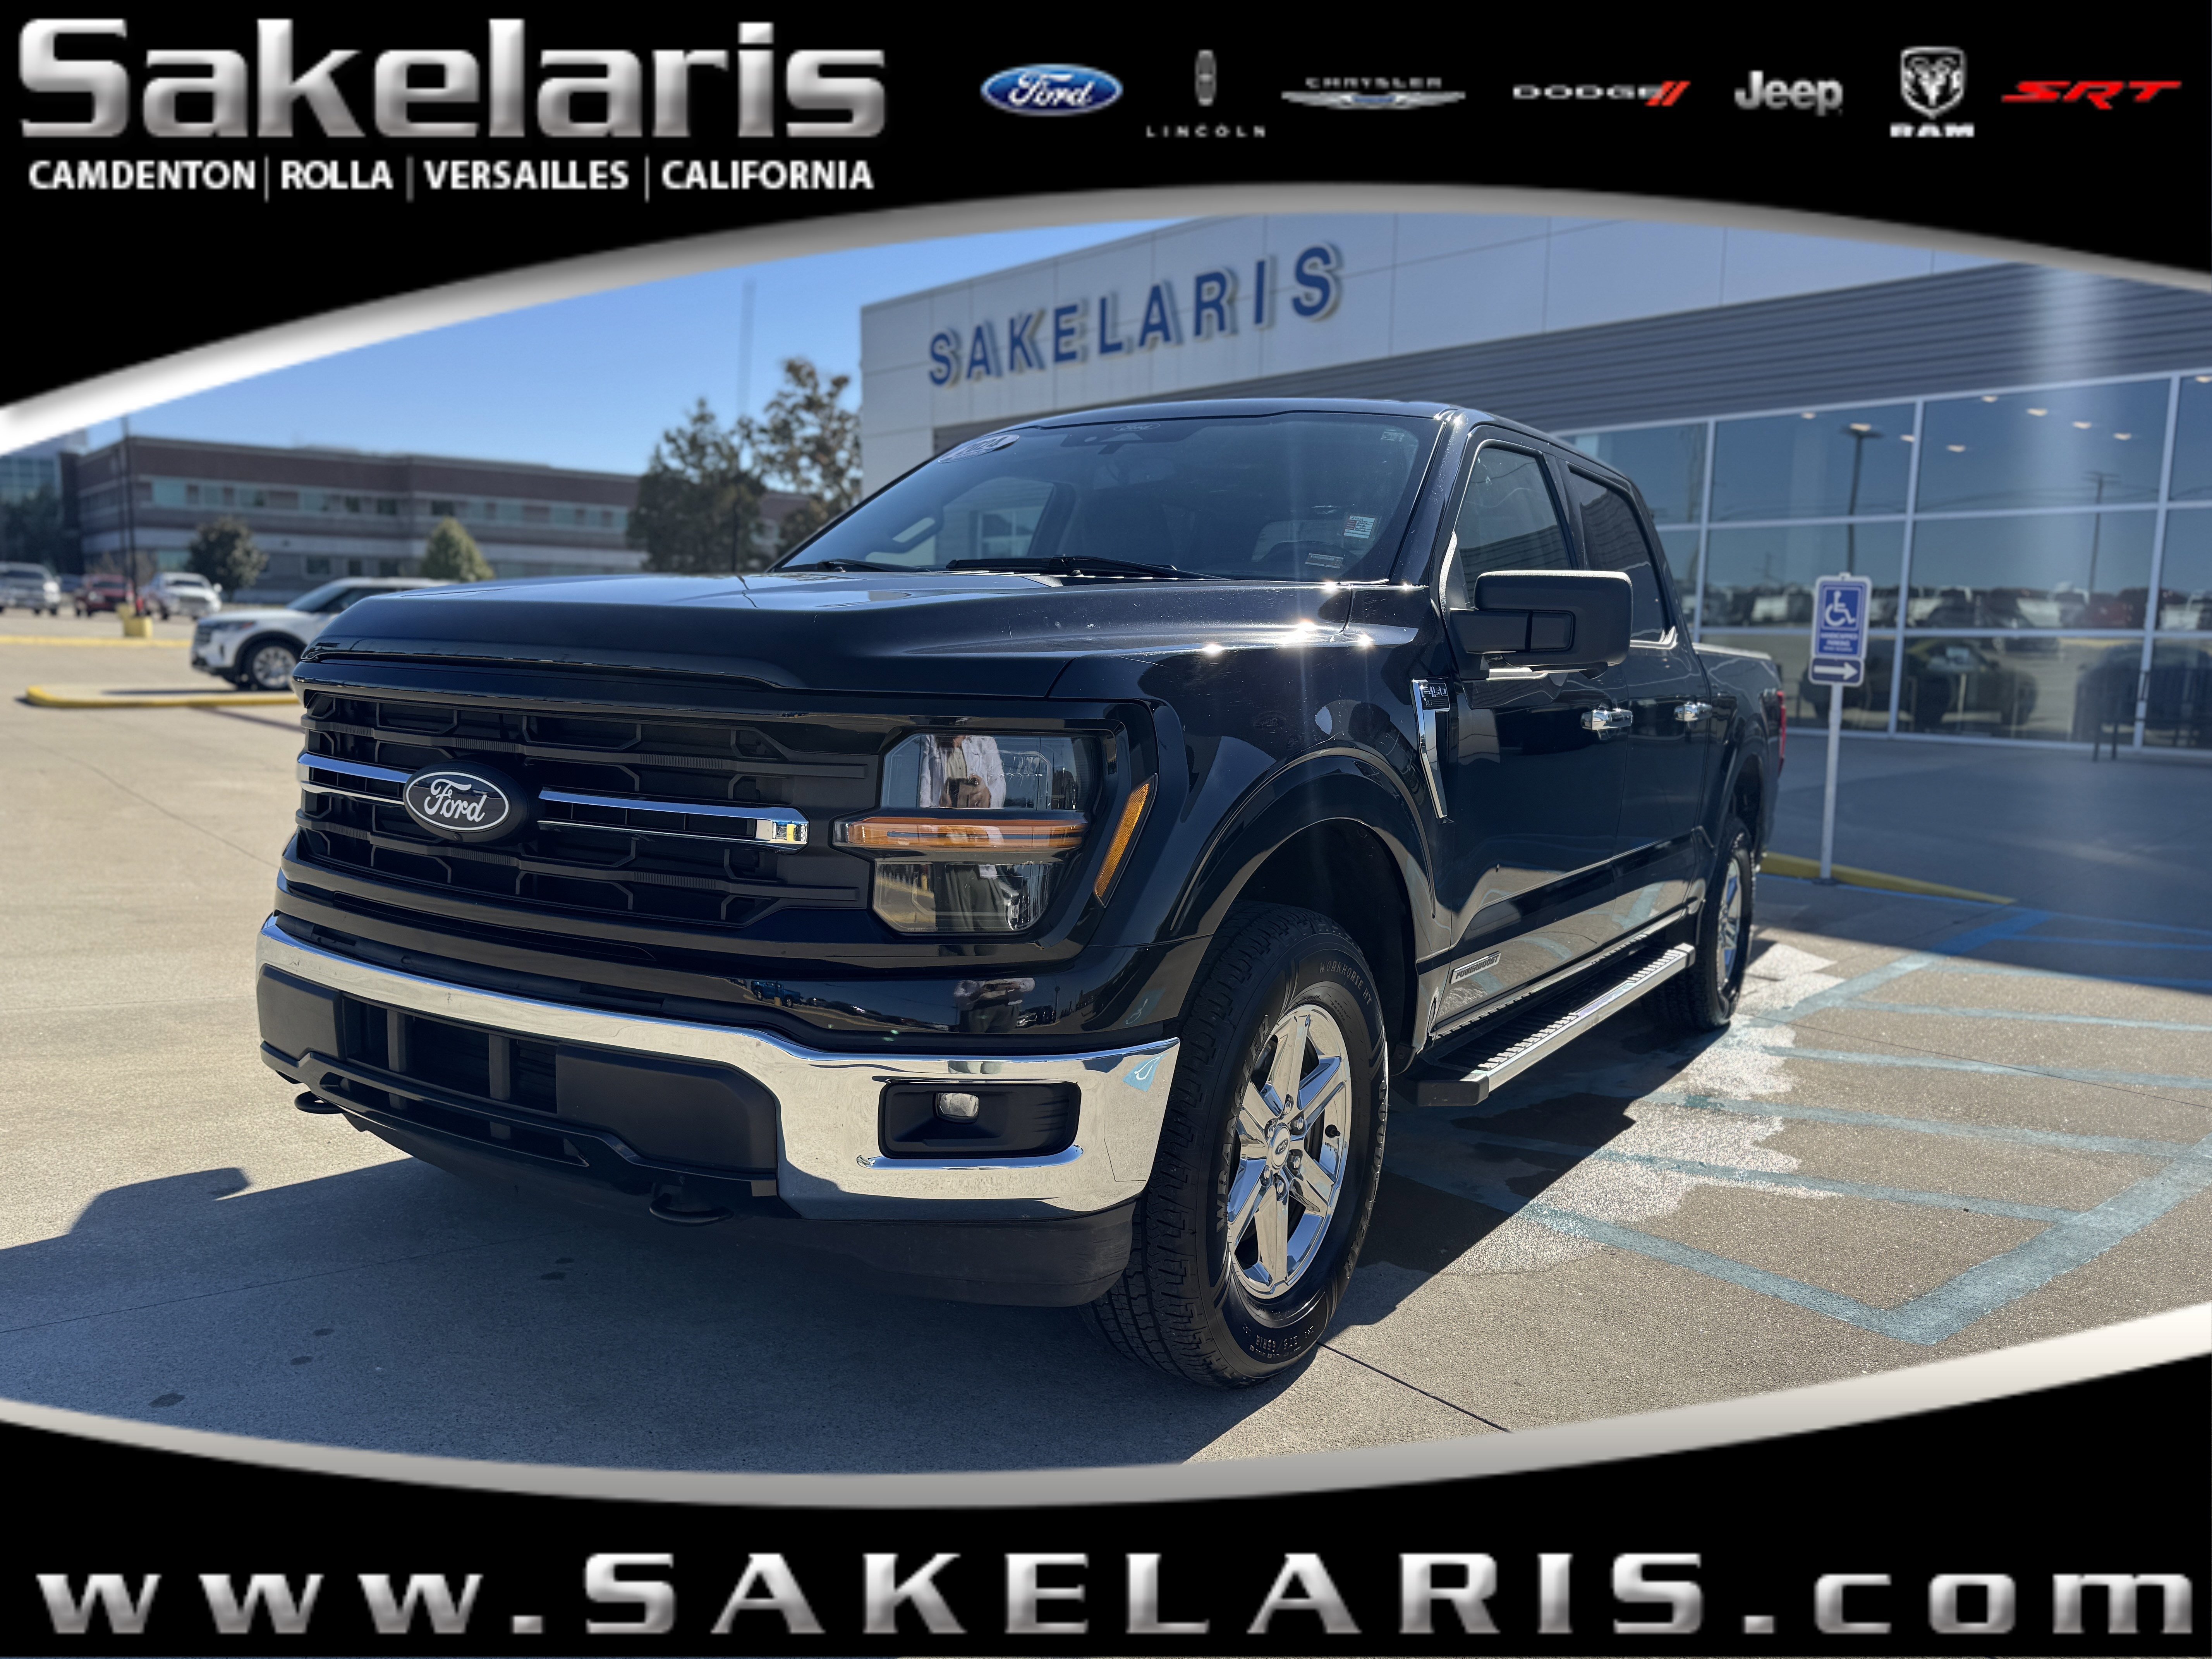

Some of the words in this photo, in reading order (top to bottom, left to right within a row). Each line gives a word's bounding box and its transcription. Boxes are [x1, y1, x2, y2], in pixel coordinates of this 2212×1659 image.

[929, 246, 1334, 386] SAKELARIS
[424, 778, 488, 822] Ford
[1320, 960, 1364, 990] WORKHORSE
